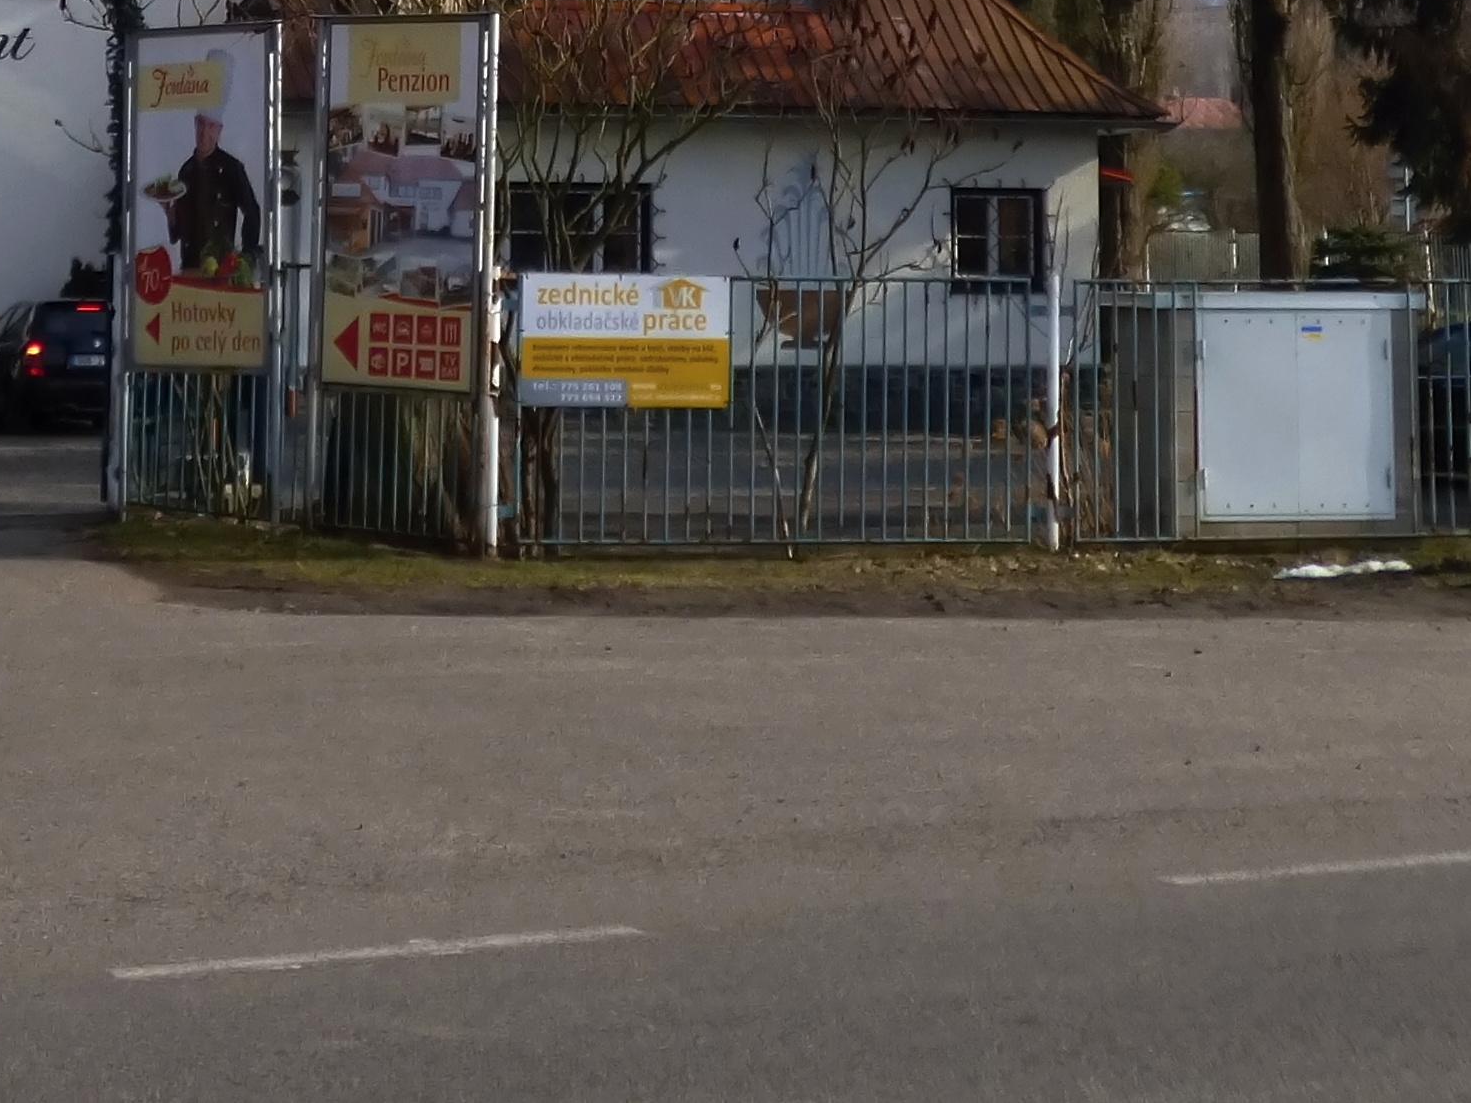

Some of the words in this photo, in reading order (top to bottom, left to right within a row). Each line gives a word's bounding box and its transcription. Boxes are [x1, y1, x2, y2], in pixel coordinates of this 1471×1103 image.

[377, 66, 450, 93] Penzion
[536, 281, 641, 307] zednické
[171, 301, 236, 329] Hotovky
[536, 311, 640, 332] obkladačské
[642, 307, 708, 336] práce
[171, 334, 190, 356] po
[195, 329, 228, 355] celý
[231, 330, 261, 352] den
[395, 351, 409, 375] P
